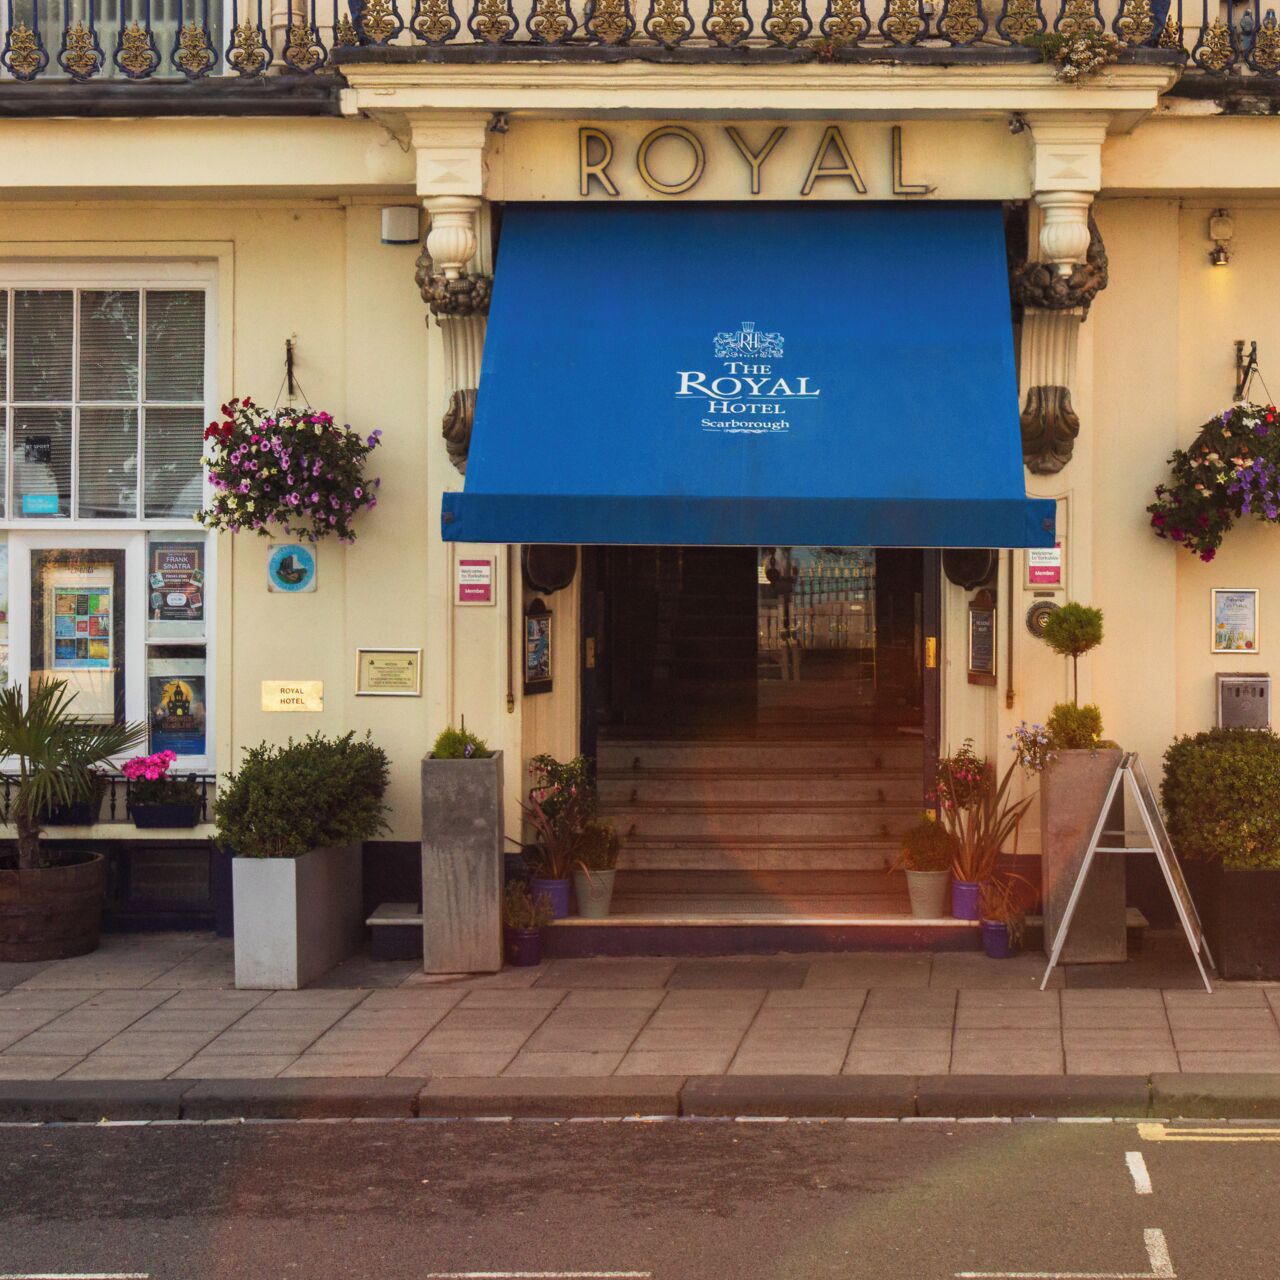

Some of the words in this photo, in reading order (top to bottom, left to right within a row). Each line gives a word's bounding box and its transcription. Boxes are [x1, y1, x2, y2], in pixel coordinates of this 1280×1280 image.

[578, 125, 929, 197] ROYAL
[723, 361, 772, 375] THE
[675, 371, 820, 400] ROYAL
[707, 400, 786, 414] HOTEL
[701, 418, 790, 430] Scarborough
[280, 687, 304, 695] ROYAL
[280, 697, 305, 705] HOTEL
